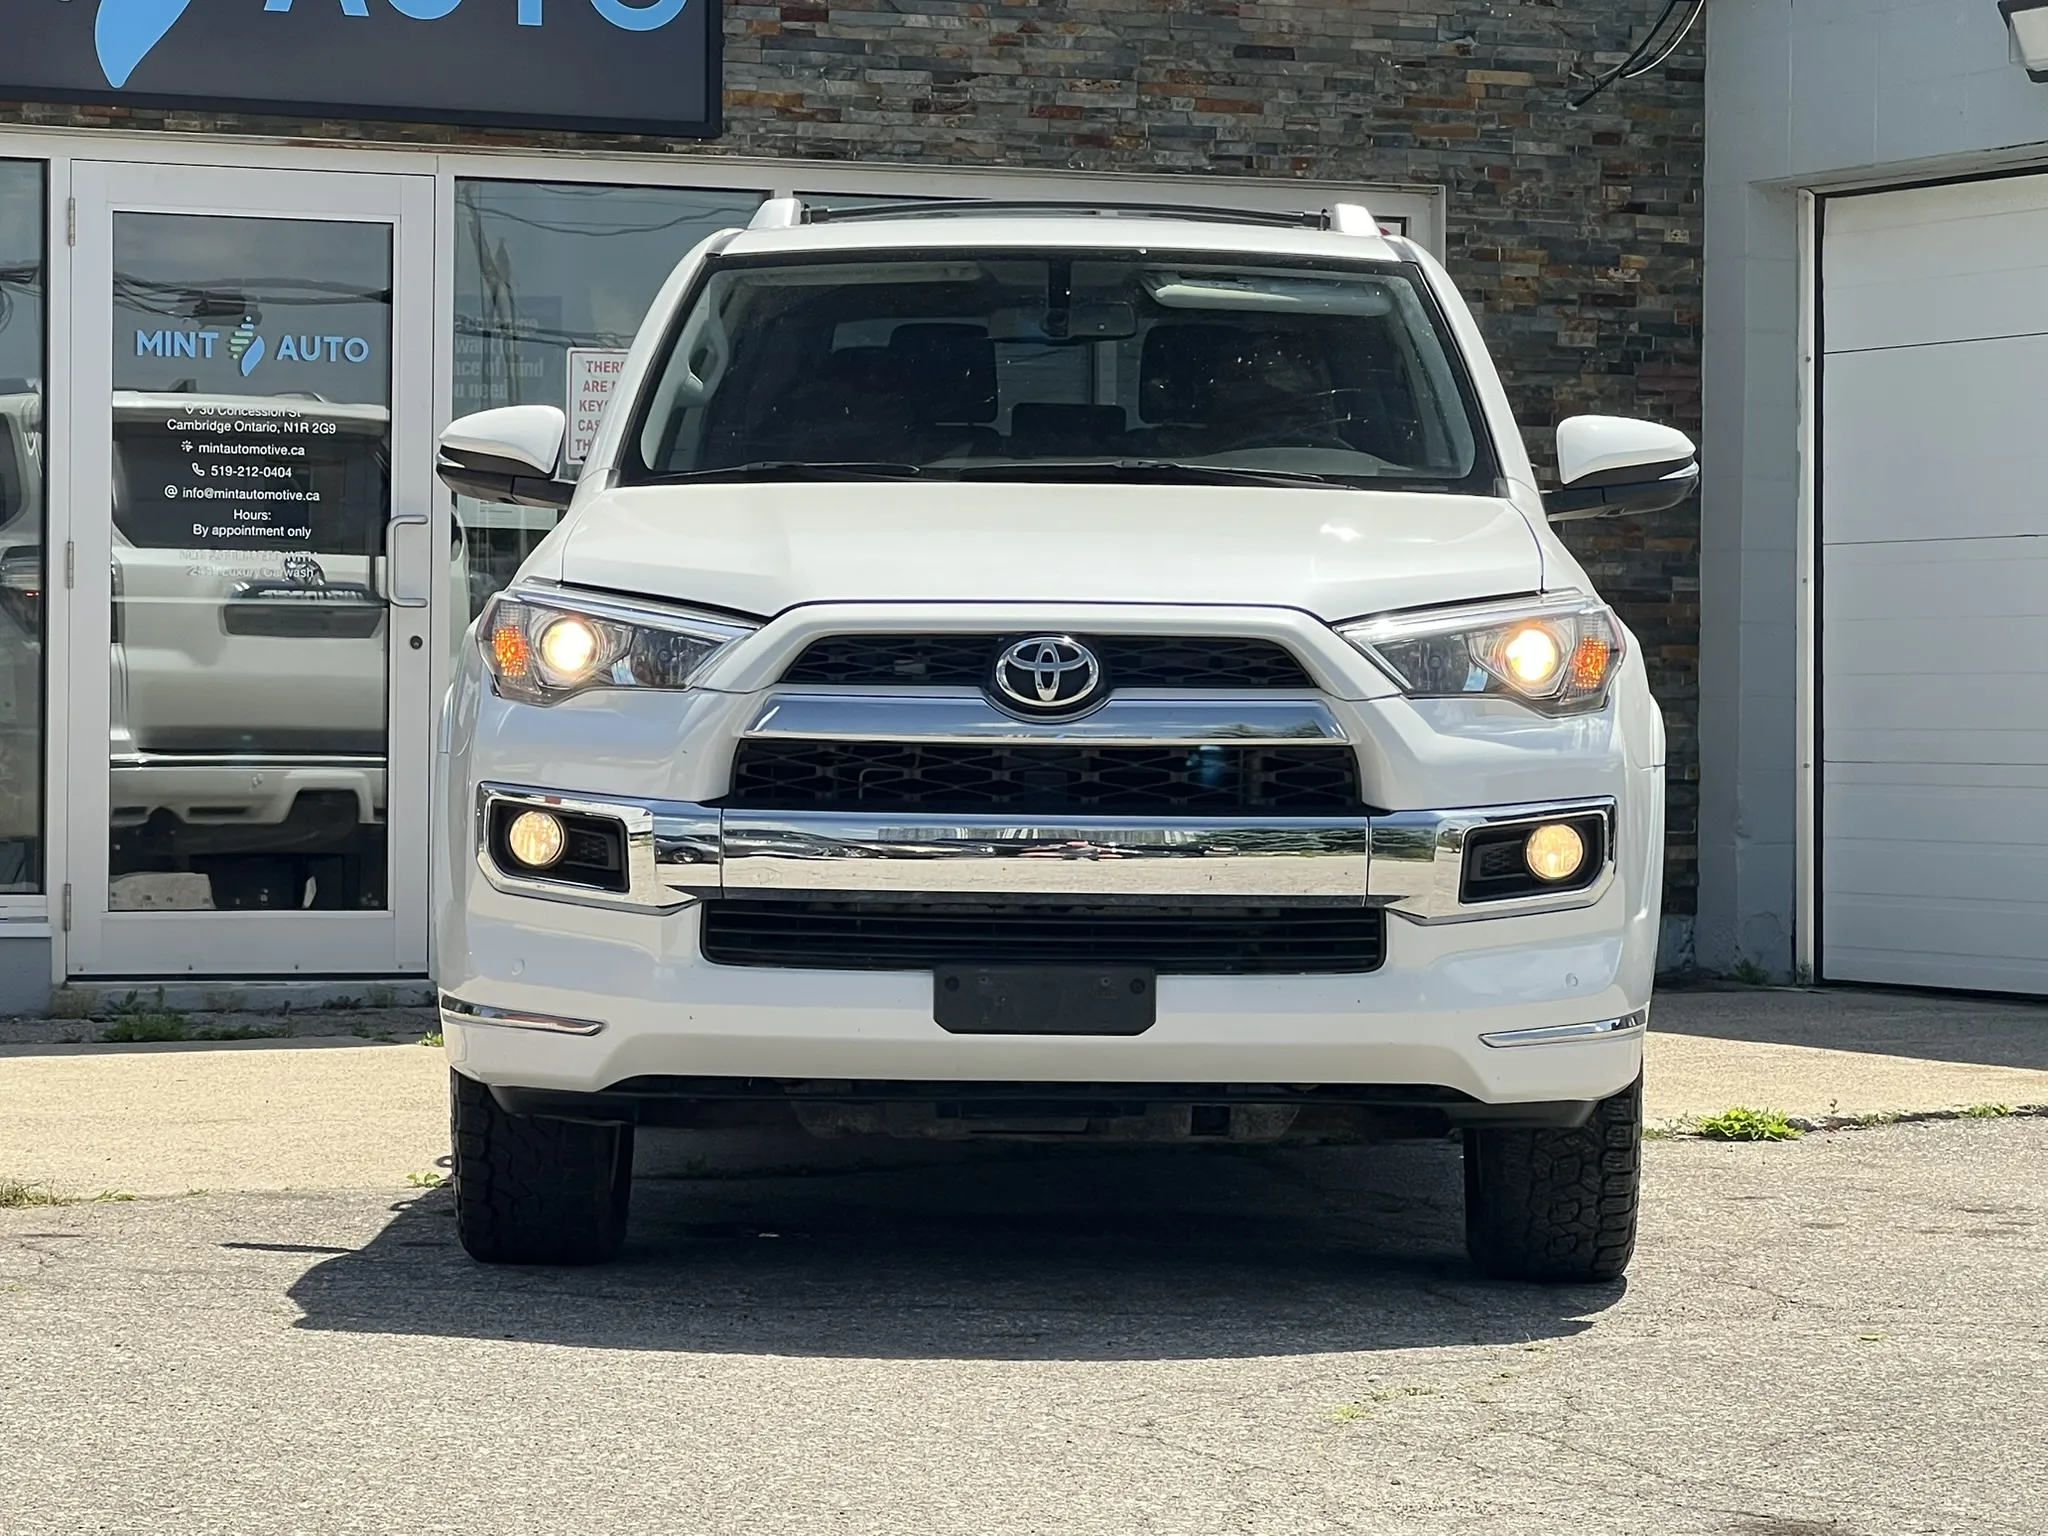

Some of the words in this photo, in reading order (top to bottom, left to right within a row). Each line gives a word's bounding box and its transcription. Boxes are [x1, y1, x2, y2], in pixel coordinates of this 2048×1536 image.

[136, 330, 219, 358] MINT
[277, 335, 369, 363] AUTO
[586, 360, 624, 373] THER
[583, 380, 608, 393] ARE
[167, 419, 231, 434] Cambridge
[234, 421, 281, 435] Ontario,
[284, 422, 309, 433] N1R
[312, 423, 337, 435] 2G9
[198, 443, 305, 456] mintautomotive.ca
[210, 465, 292, 479] 519-212-0404
[182, 486, 320, 502] info@mintautomotive.ca
[233, 509, 272, 521] Hours:
[192, 524, 210, 537] By
[211, 525, 285, 538] appointment
[287, 527, 312, 540] only
